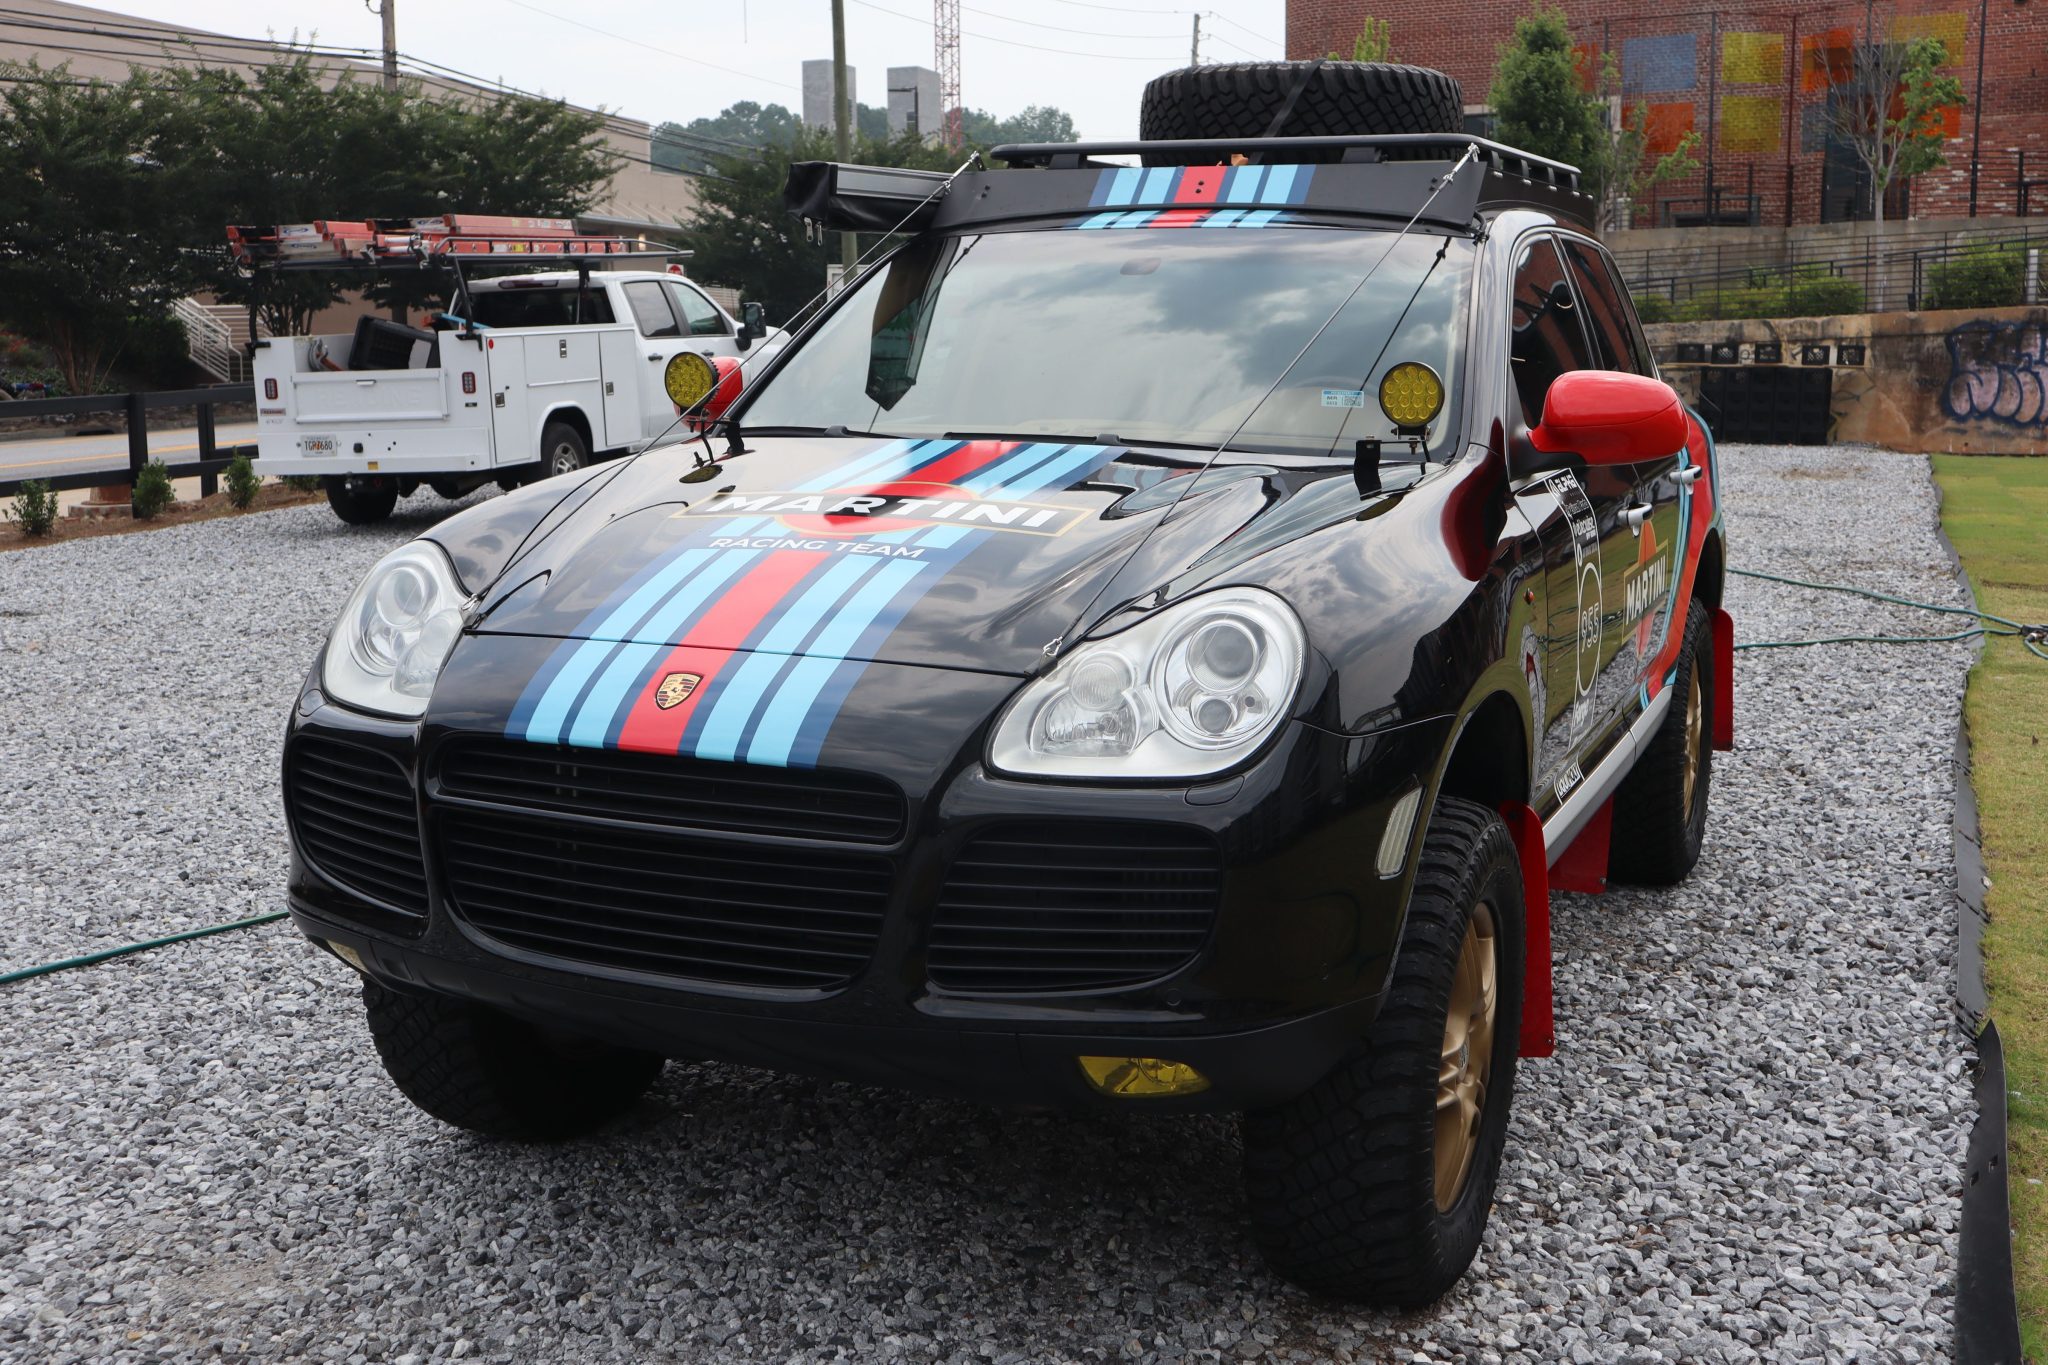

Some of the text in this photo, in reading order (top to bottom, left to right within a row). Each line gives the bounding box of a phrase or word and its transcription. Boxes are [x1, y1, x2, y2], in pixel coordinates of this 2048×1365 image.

[705, 494, 1060, 528] MARTINI
[709, 537, 926, 559] RACING TEAM
[1626, 554, 1666, 627] MARTINI
[1581, 602, 1600, 654] 955
